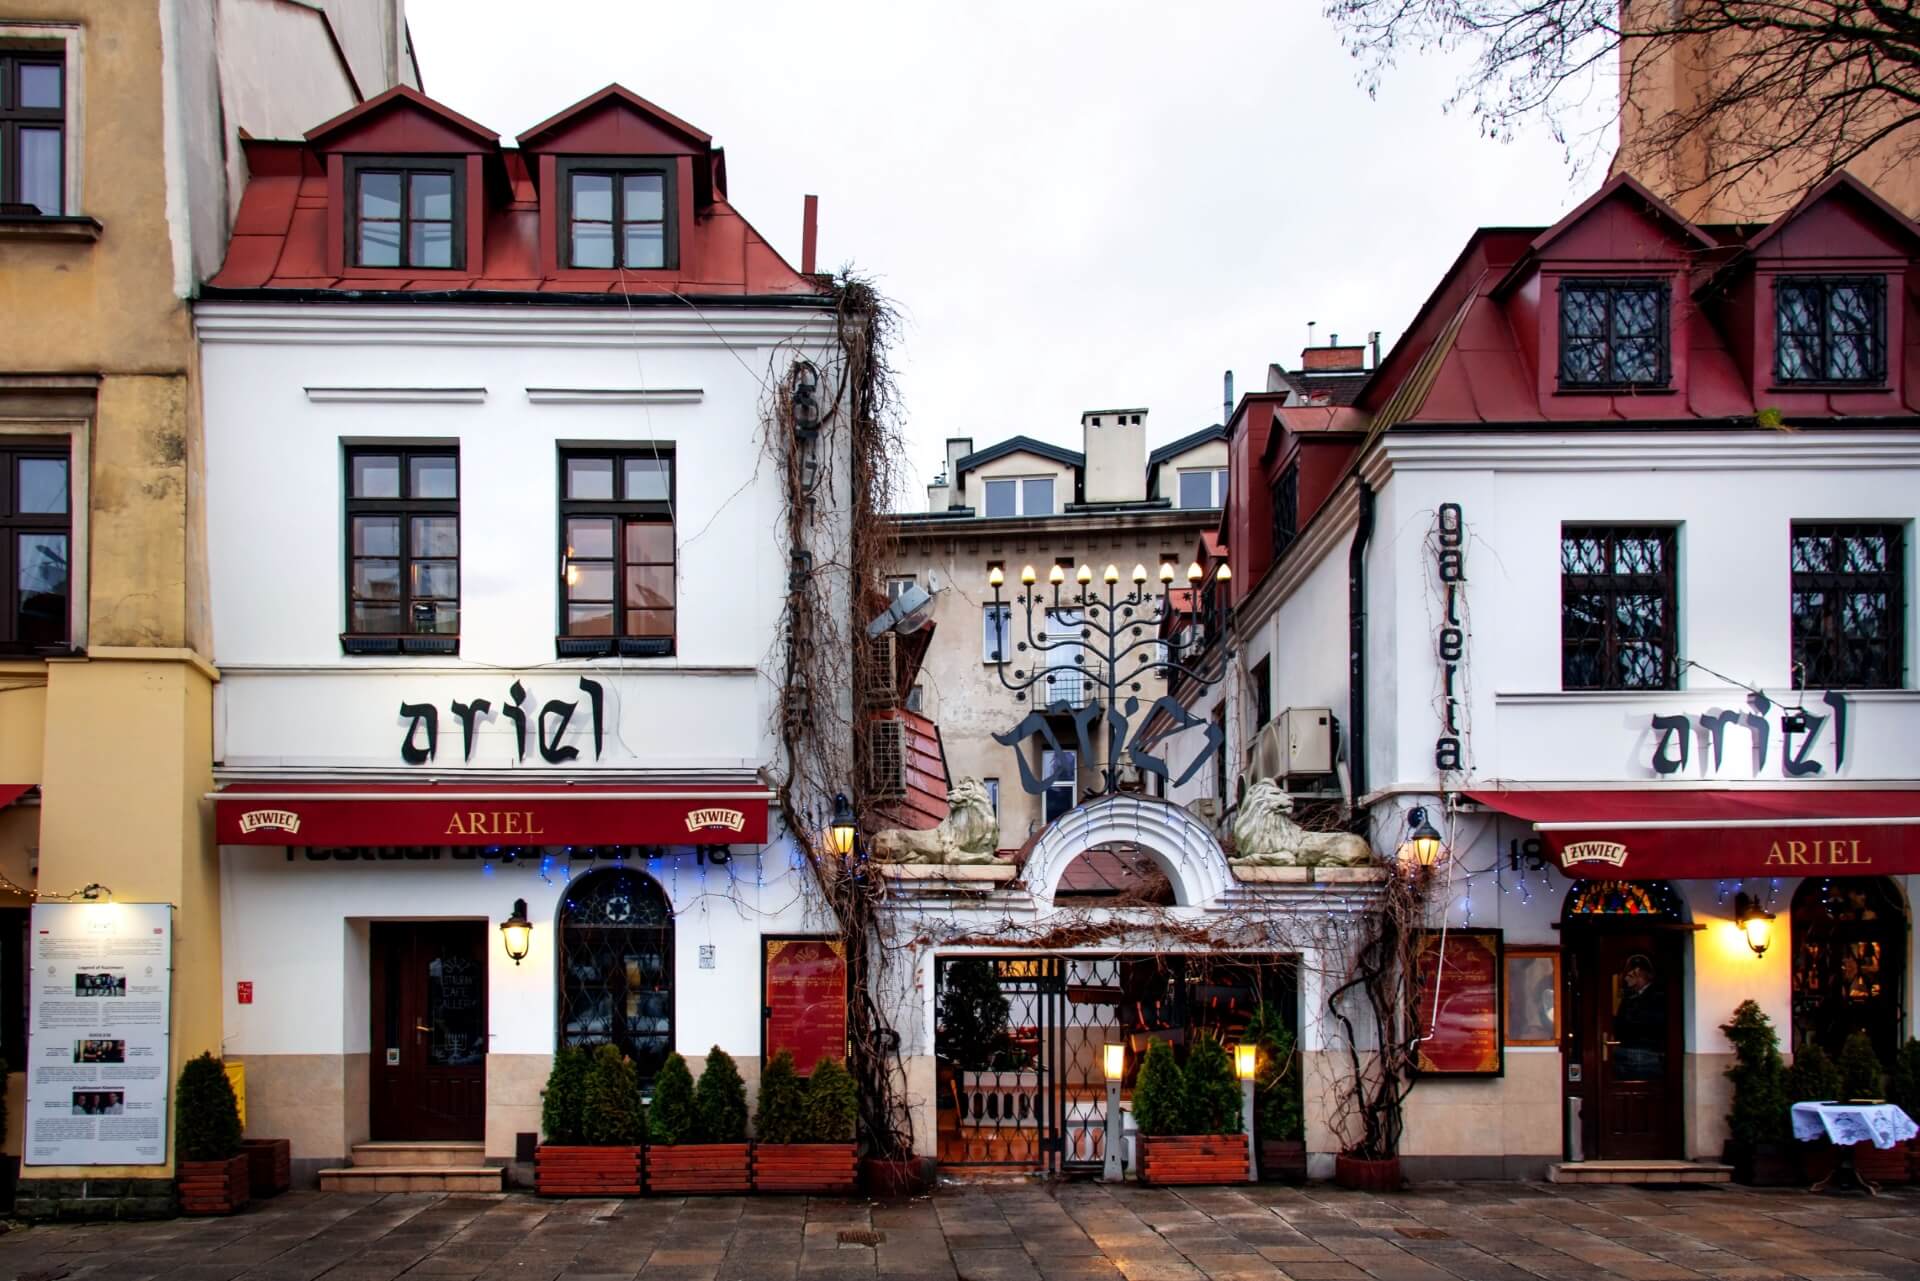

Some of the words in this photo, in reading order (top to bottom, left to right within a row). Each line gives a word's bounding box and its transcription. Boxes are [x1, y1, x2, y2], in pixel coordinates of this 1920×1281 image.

[1436, 502, 1467, 771] galeria
[400, 675, 603, 765] ariel
[1652, 689, 1846, 775] ariel
[444, 811, 544, 834] ARIEL
[1765, 840, 1872, 865] ARIEL
